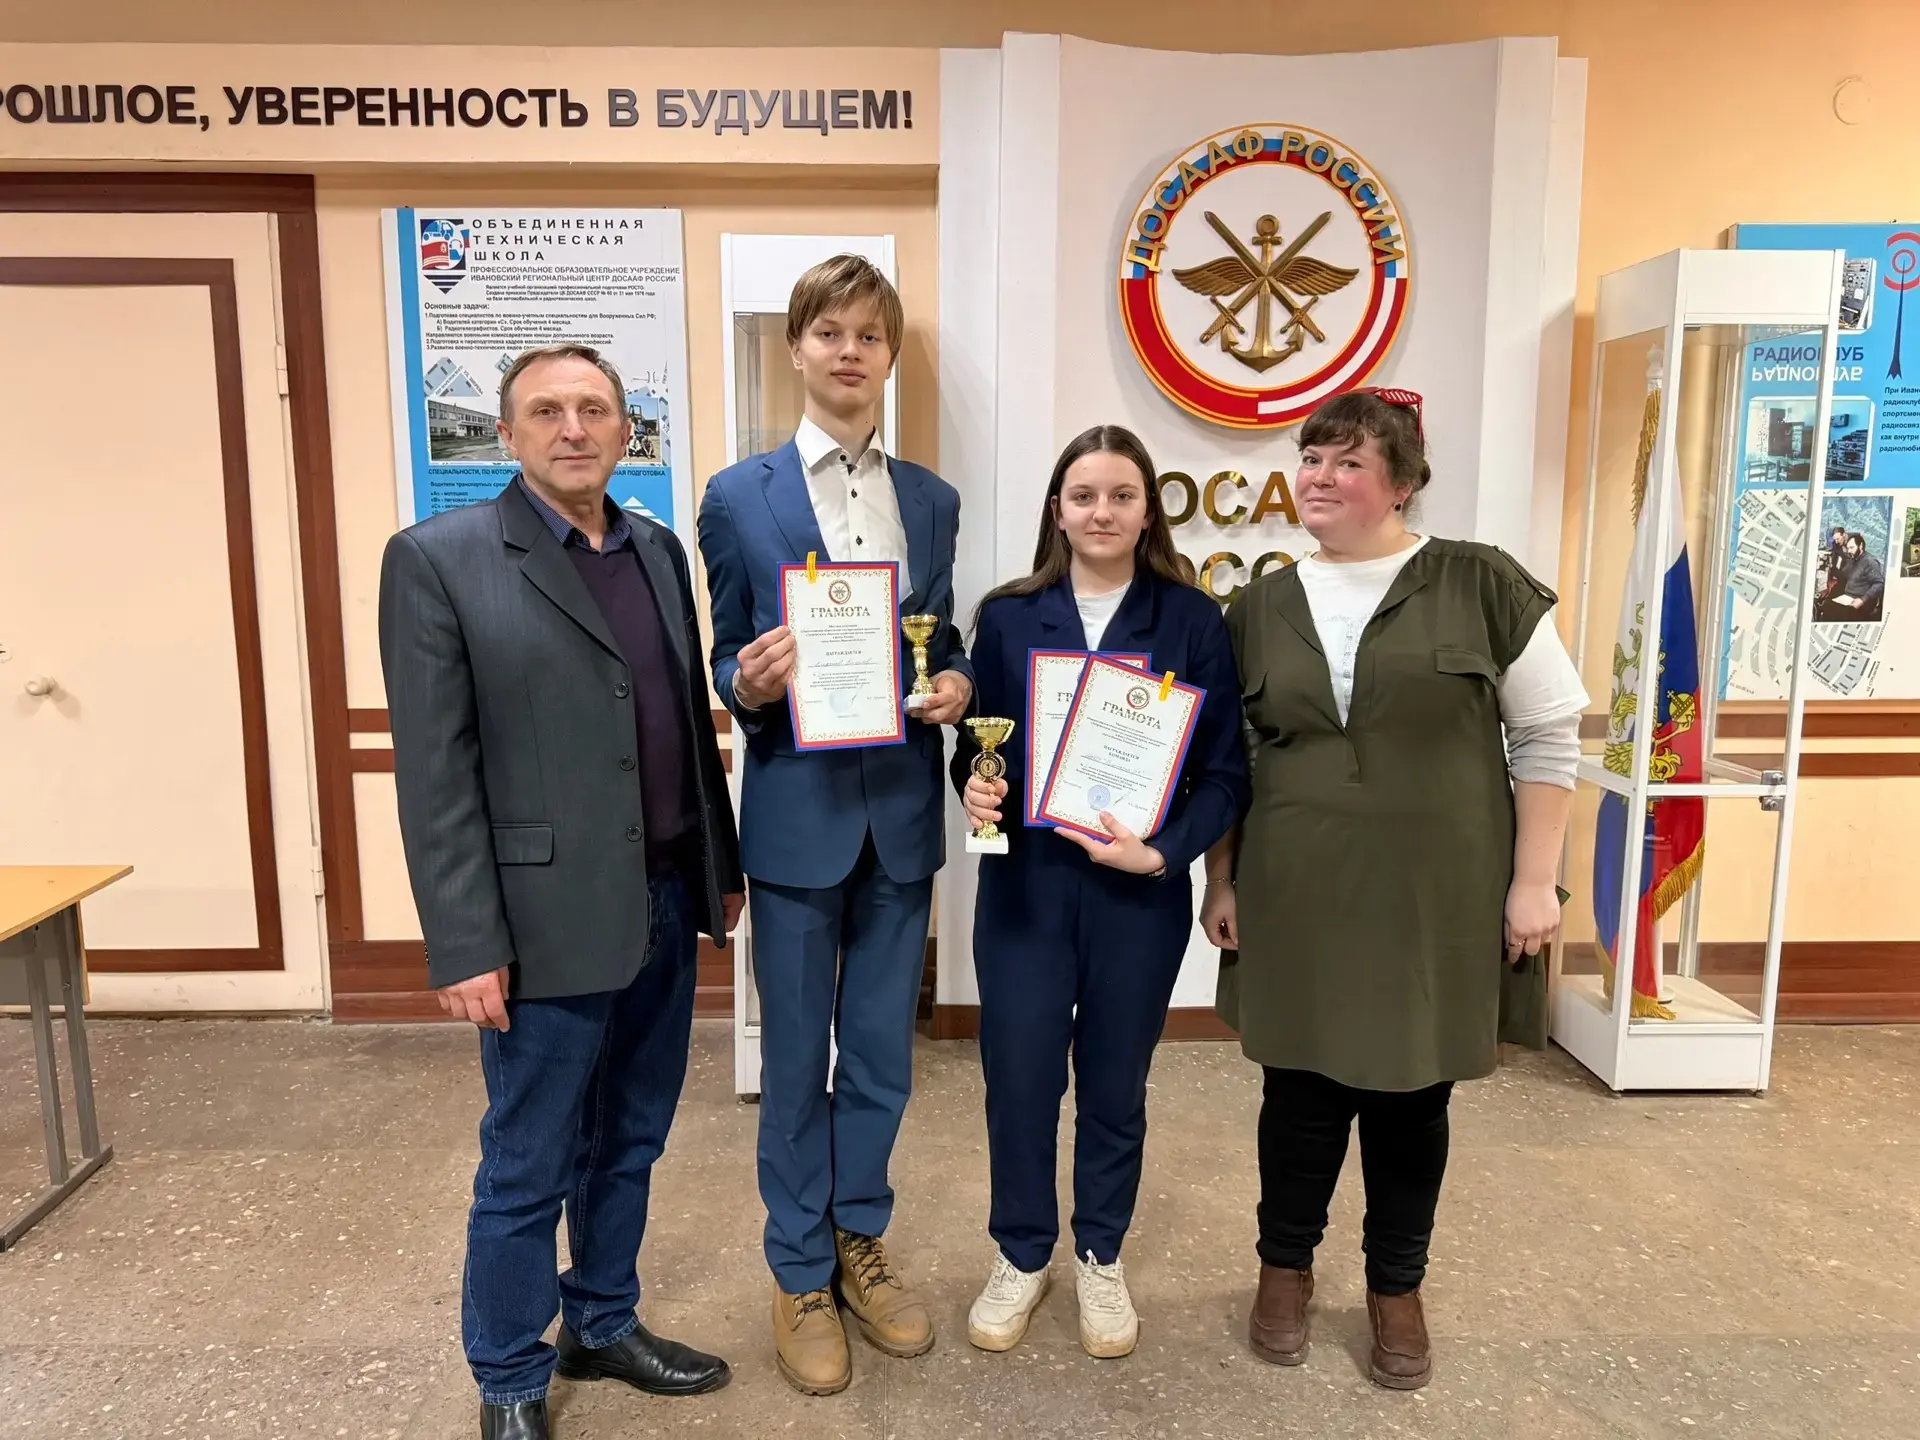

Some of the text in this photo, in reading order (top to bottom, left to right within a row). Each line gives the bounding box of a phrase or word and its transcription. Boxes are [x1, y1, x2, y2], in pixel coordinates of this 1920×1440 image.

[0, 84, 914, 136] ОШЛОЕ, УВЕРЕННОСТЬ В БУДУЩЕМ!
[1127, 128, 1405, 273] ДОСААФ РОССИИ
[472, 219, 643, 231] ОБЪЕДИНЕННАЯ
[472, 235, 624, 245] ТЕХНИЧЕСКАЯ
[474, 251, 544, 261] ШКОЛА
[470, 266, 680, 275] ПРОФЕССИОНАЛЬНОЕ ОБРАЗОВАТЕЛЬНОЕ УЧРЕЖДЕНИЕ
[470, 274, 676, 283] ИВАНОВСКИЙ РЕГИОНАЛЬНЫЙ ЦЕНТР ДОСААФ РОССИИ
[424, 302, 490, 311] Основные задачи:
[1753, 346, 1864, 364] РАДИОУБ
[1884, 386, 1899, 395] При
[428, 468, 481, 476] СПЕЦИАЛЬНОСТИ,
[1156, 471, 1301, 526] ОСА
[810, 606, 871, 618] ГРАМОТА
[1101, 700, 1162, 730] ГРАМОТА
